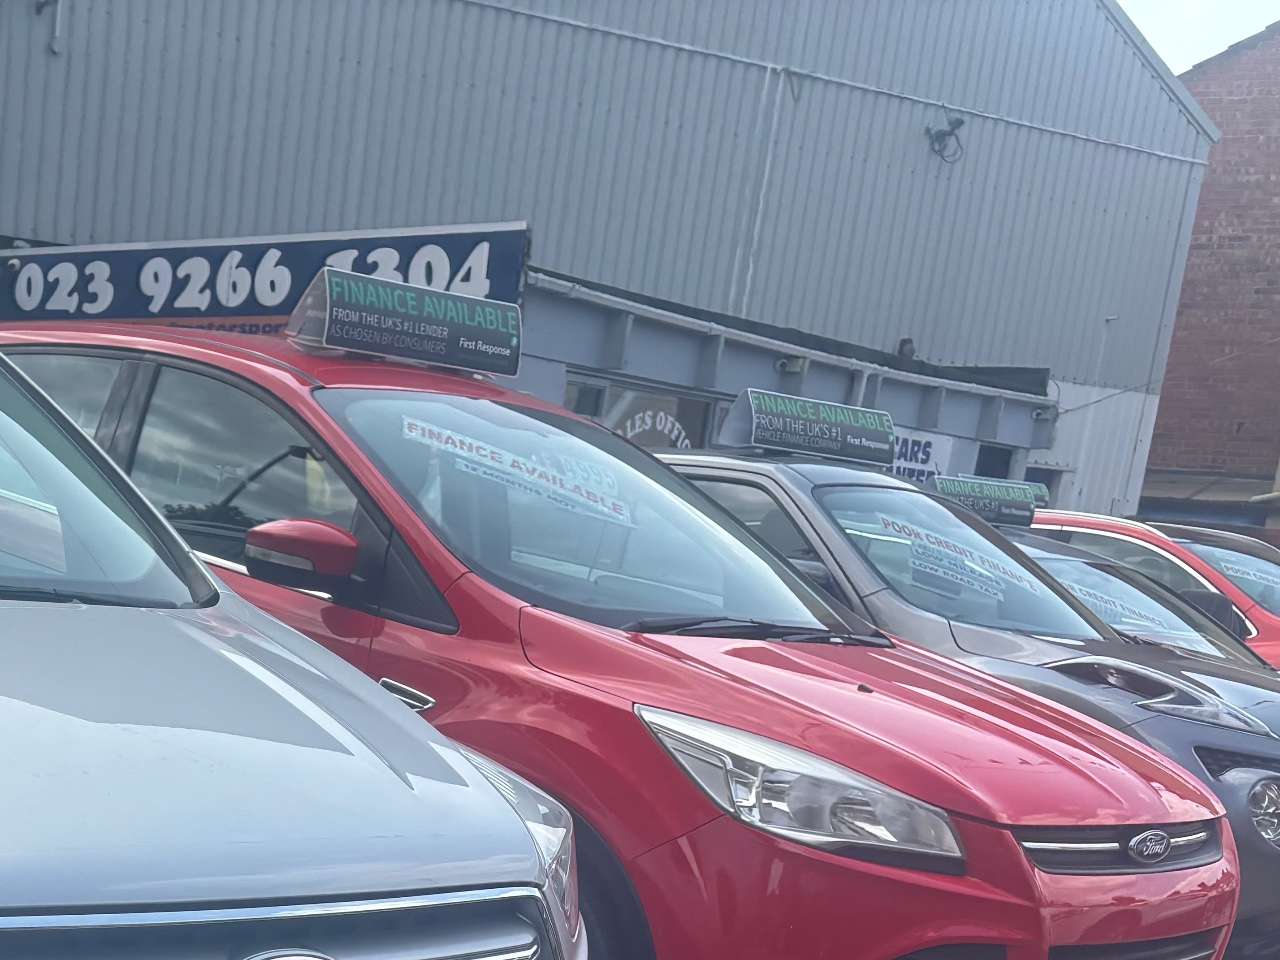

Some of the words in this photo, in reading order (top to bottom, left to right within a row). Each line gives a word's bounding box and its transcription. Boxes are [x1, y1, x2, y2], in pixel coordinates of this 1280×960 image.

[14, 259, 115, 315] 023
[139, 247, 292, 314] 9266
[330, 276, 418, 316] FINANCE
[423, 295, 518, 335] AVAILABLE
[332, 306, 360, 324] FROM
[361, 311, 379, 329] THE
[380, 315, 403, 332] UK'S
[403, 320, 413, 334] #1
[415, 320, 449, 340] LENDER
[329, 324, 342, 338] AS
[342, 326, 380, 345] CHOSEN
[380, 331, 394, 346] BY
[394, 334, 448, 354] CONSUMERS
[458, 336, 476, 351] First
[477, 340, 512, 358] Response
[617, 410, 654, 439] LES
[751, 392, 817, 419] FINANCE
[820, 404, 892, 433] AVAILABLE
[754, 413, 784, 431] FROM
[785, 417, 805, 434] THE
[807, 421, 830, 439] UK'S
[831, 426, 842, 441] #1
[895, 436, 933, 465] ARS
[406, 420, 505, 465] FINANCE
[511, 458, 625, 517] AVAILABLE
[937, 481, 981, 499] FINANCE
[983, 485, 1034, 501] AVAILABLE
[881, 516, 926, 544] POOR
[926, 532, 976, 561] CREDIT
[1143, 833, 1167, 856] Ford
